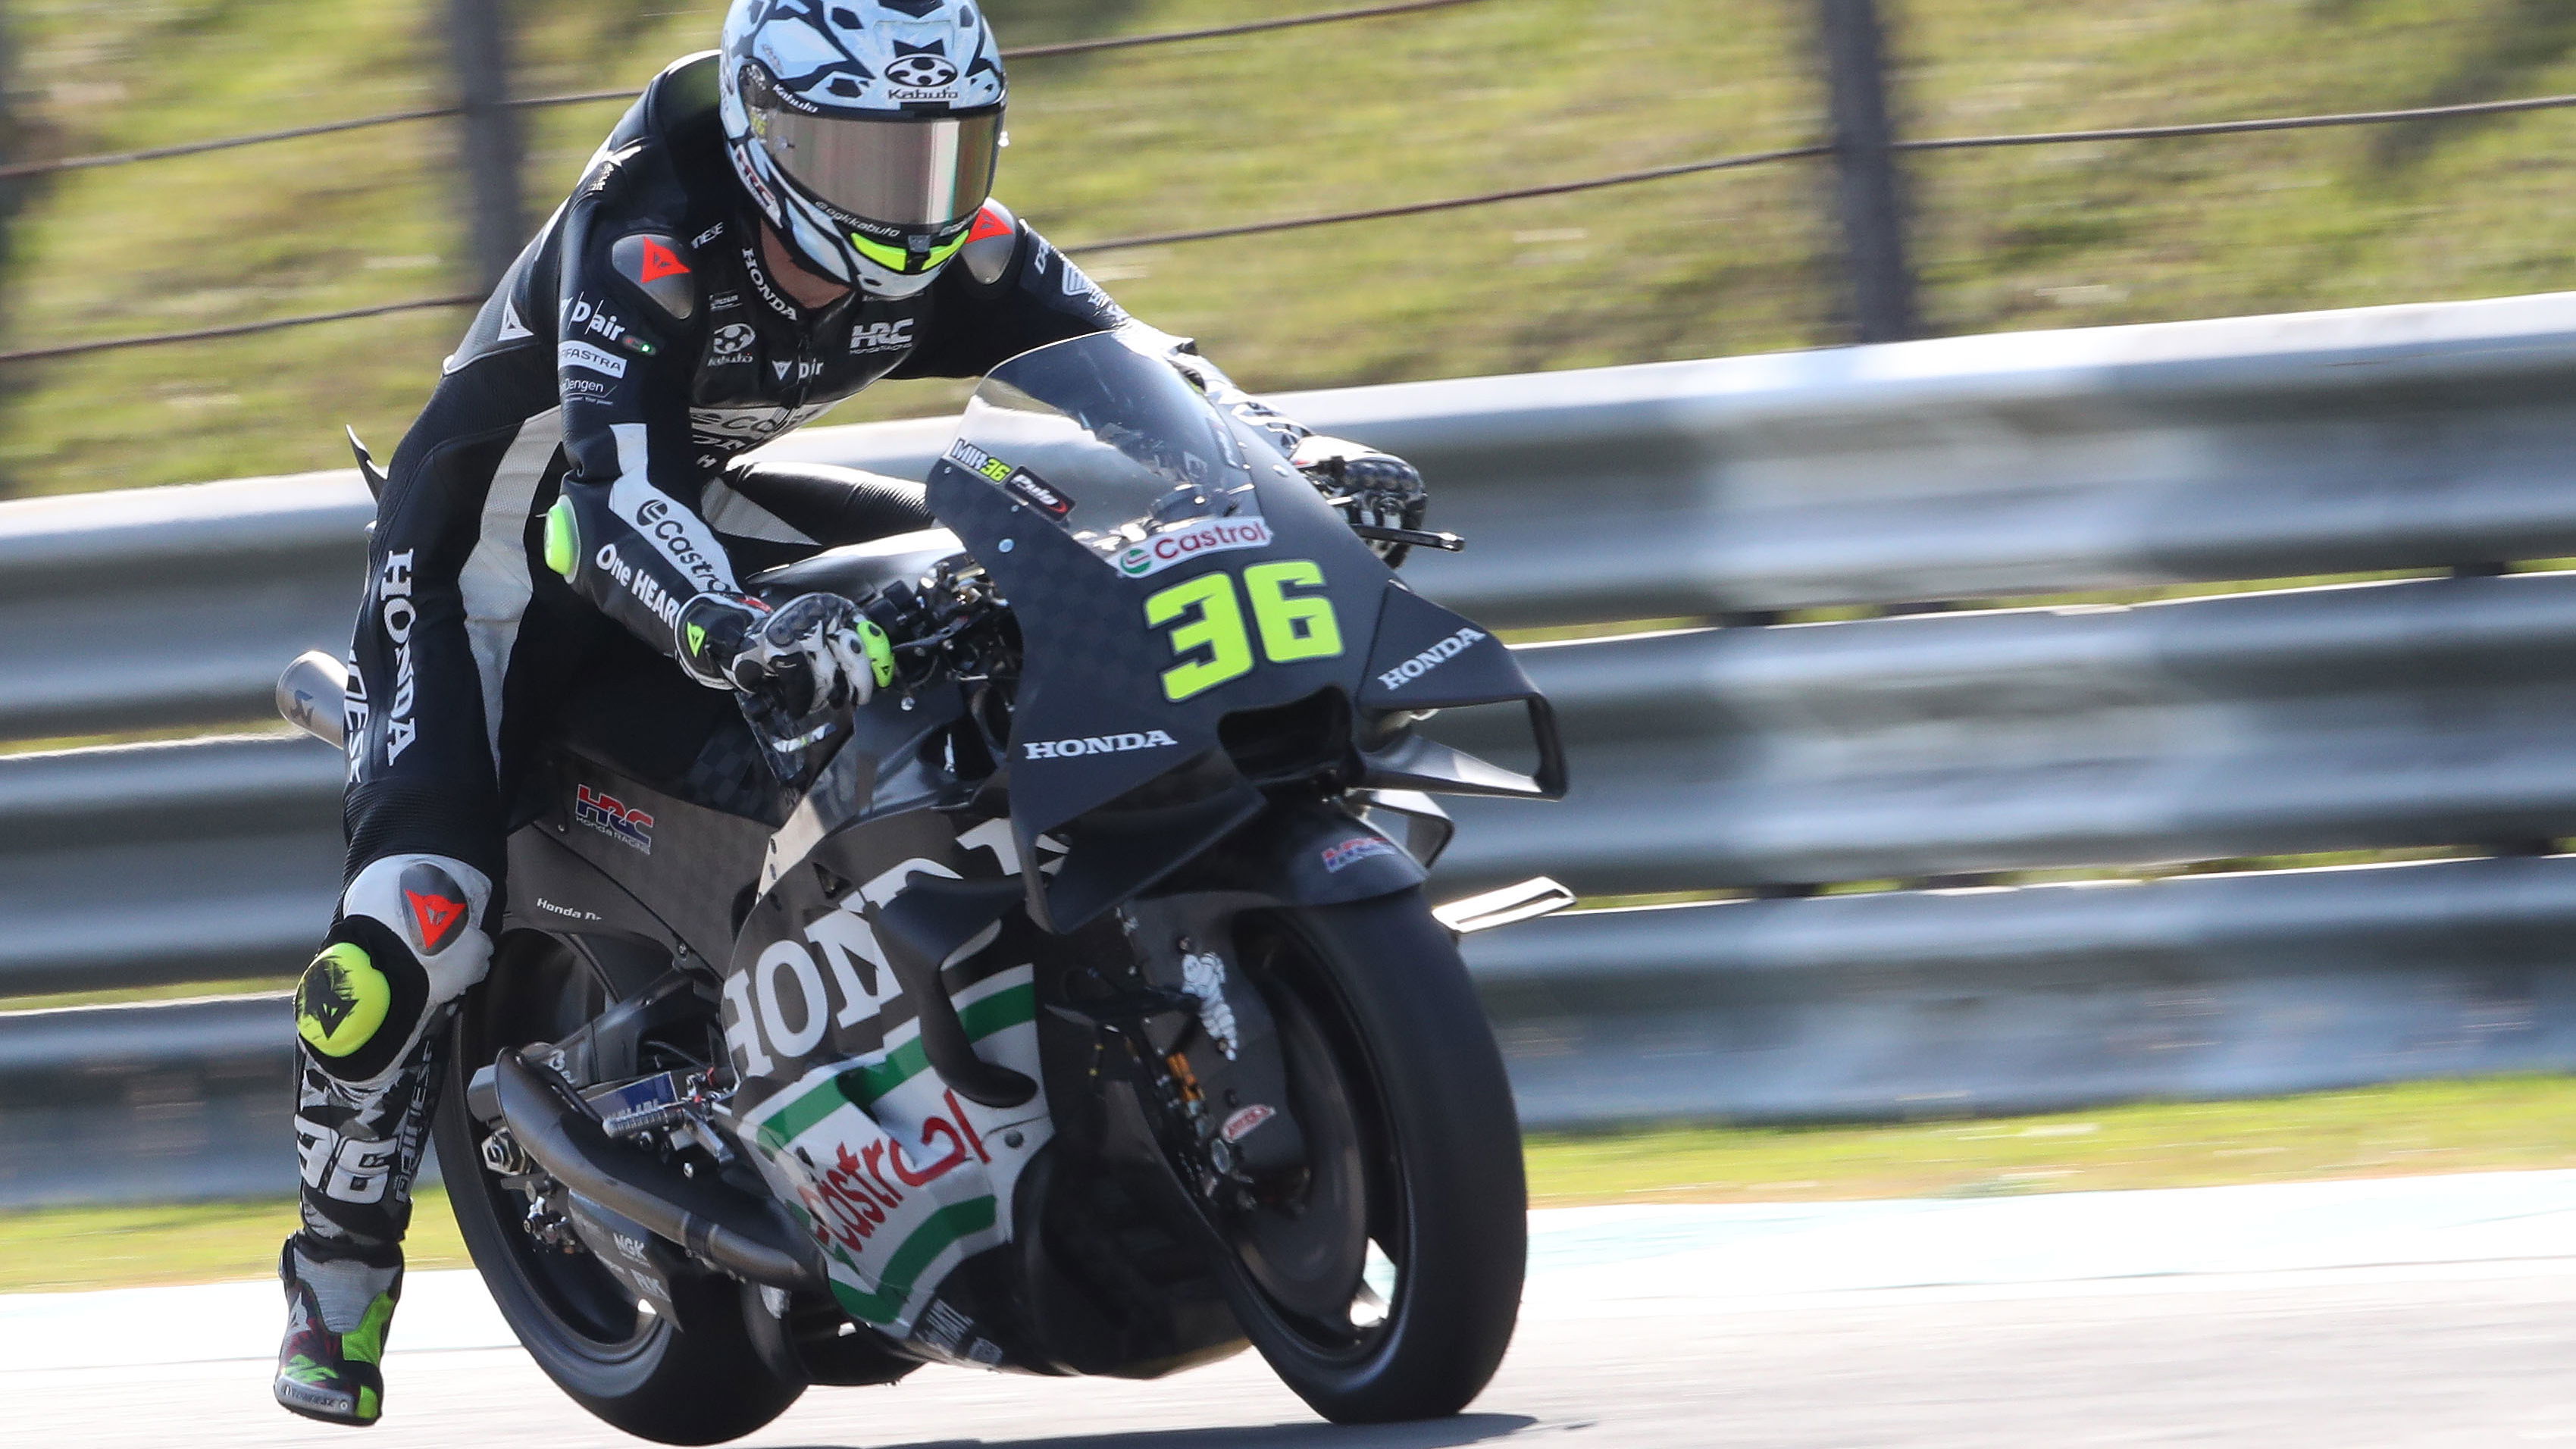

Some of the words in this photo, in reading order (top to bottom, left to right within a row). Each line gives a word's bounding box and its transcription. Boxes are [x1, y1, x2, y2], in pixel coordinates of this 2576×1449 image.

[773, 83, 818, 113] Kabuto
[887, 86, 959, 100] Kabuto
[742, 247, 797, 321] HONDA
[850, 318, 914, 349] HRC
[655, 520, 732, 594] Castro
[1153, 521, 1268, 560] Castrol
[596, 543, 631, 587] One
[631, 566, 682, 630] HEAR
[380, 548, 417, 767] HONDA
[1145, 559, 1344, 702] 36
[1379, 627, 1485, 690] HONDA
[1022, 728, 1178, 760] HONDA
[575, 784, 654, 847] HRC
[537, 897, 582, 919] Honda
